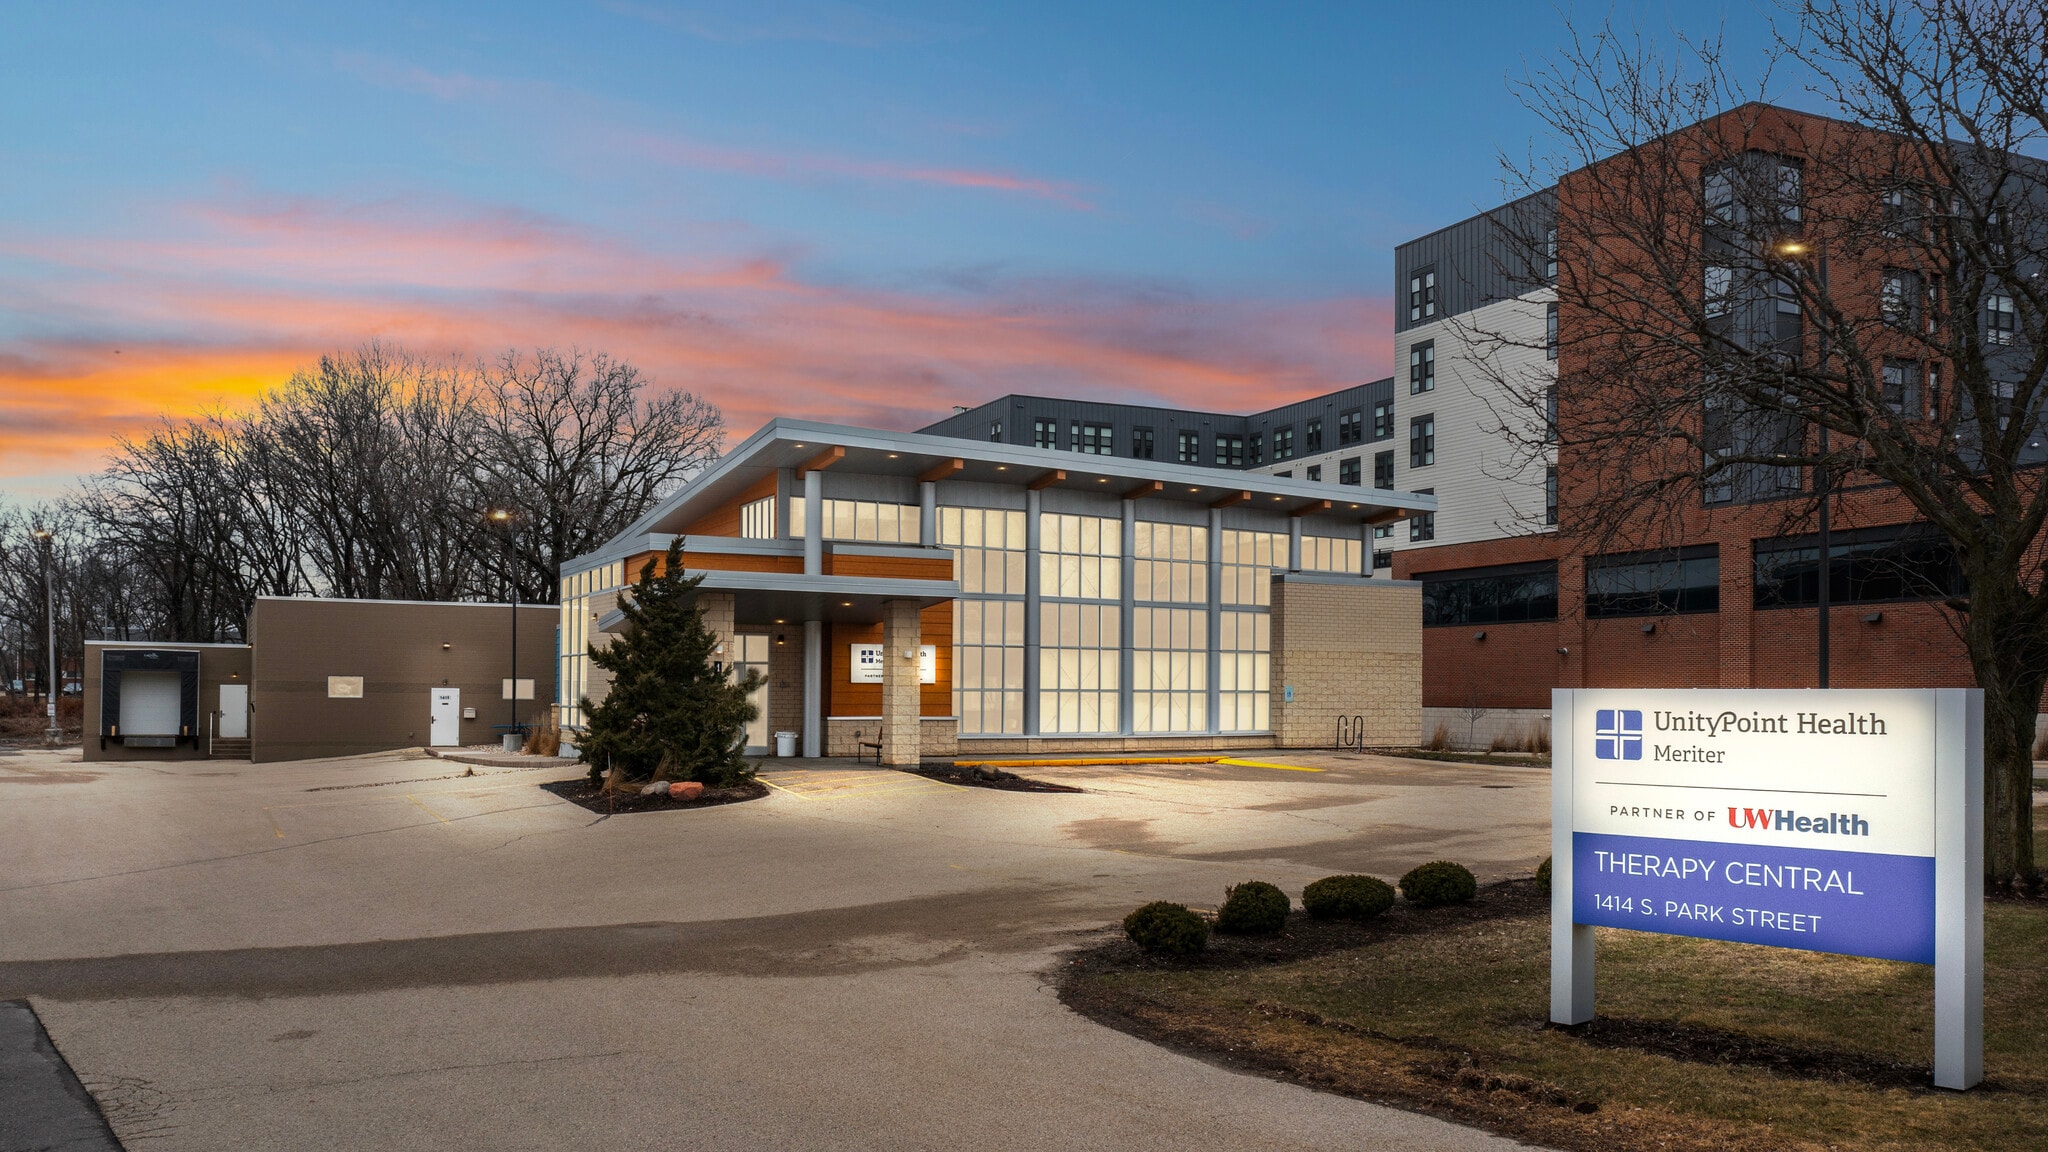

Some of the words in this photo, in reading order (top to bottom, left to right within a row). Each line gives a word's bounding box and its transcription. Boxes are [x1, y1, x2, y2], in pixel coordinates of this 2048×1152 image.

[1653, 710, 1789, 738] UnityPoint
[1796, 712, 1888, 736] Health
[1653, 744, 1726, 764] Meriter
[1610, 805, 1685, 820] PARTNER
[1693, 810, 1716, 822] OF
[1594, 850, 1716, 882] THERAPY
[1725, 861, 1864, 896] CENTRAL
[1594, 893, 1634, 913] 1414
[1640, 898, 1658, 916] S.
[1665, 900, 1724, 923] PARK
[1732, 907, 1822, 933] STREET
